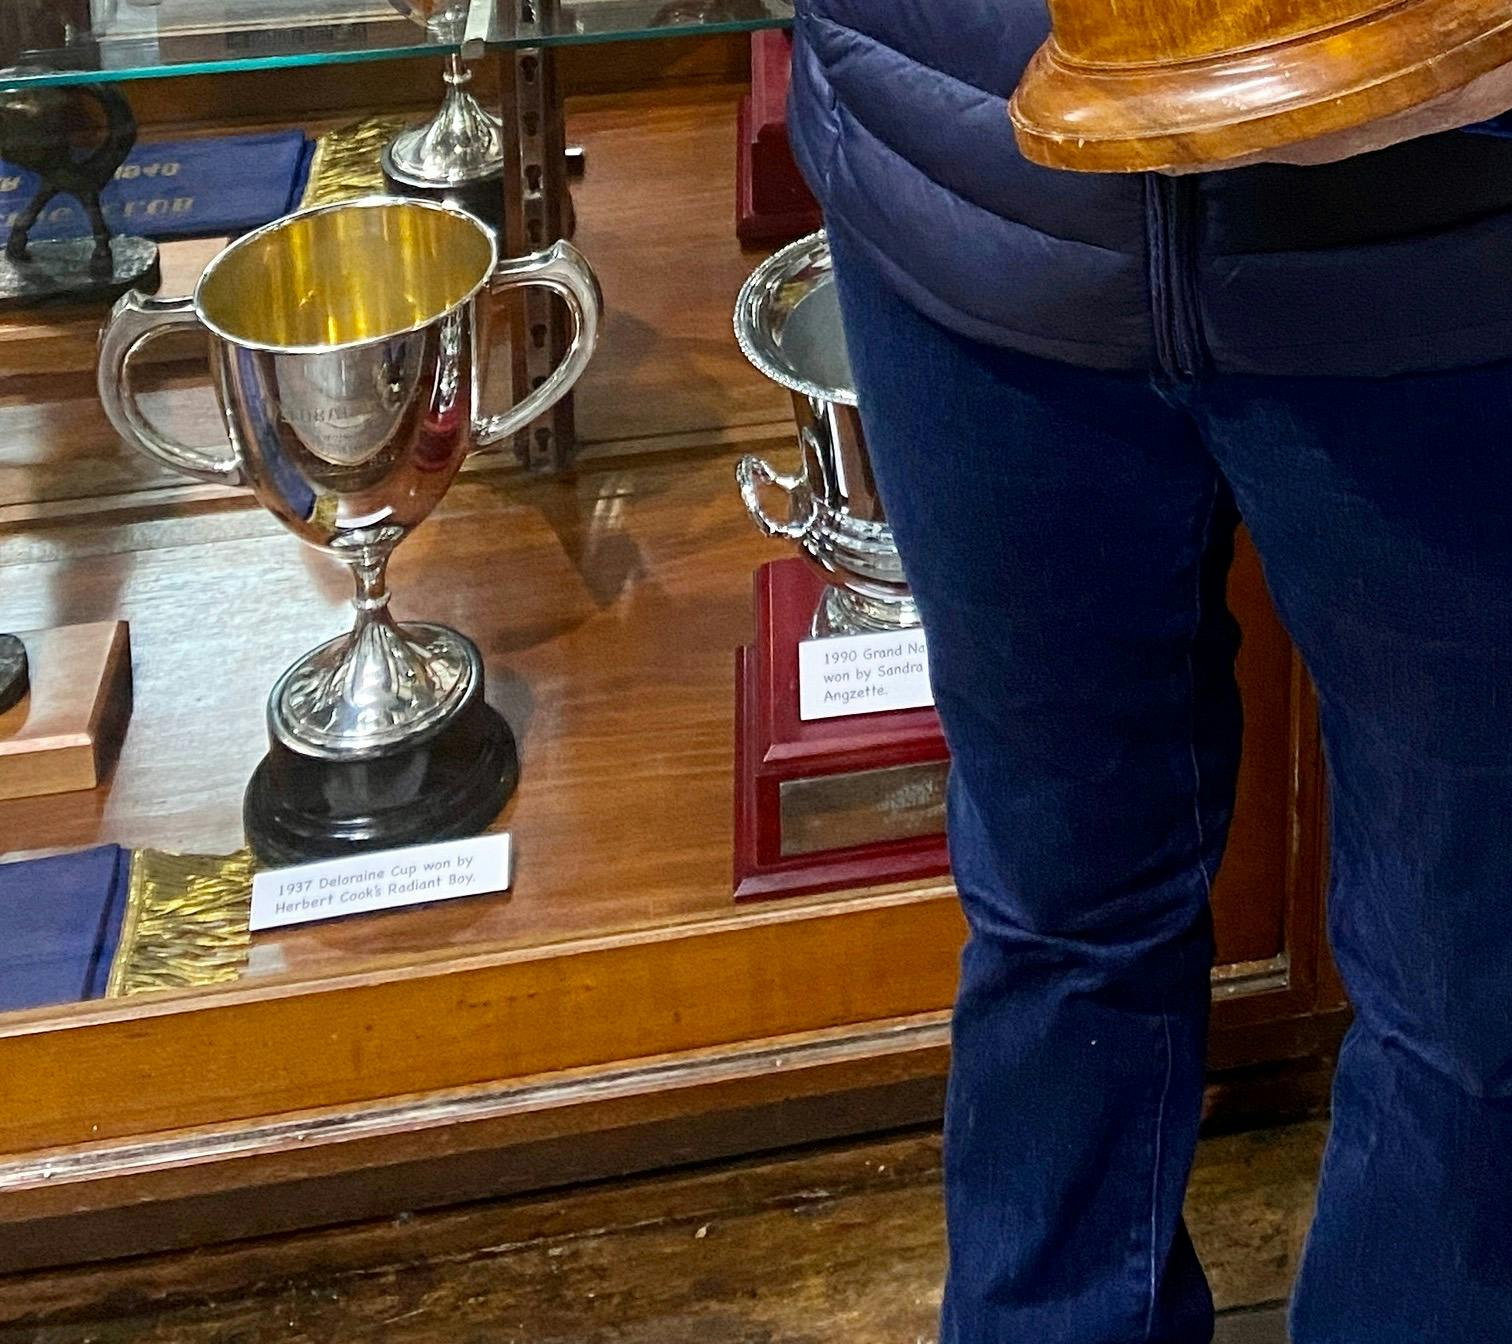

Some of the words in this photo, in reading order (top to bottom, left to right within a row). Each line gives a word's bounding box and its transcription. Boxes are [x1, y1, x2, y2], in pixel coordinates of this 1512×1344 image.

[824, 650, 857, 665] 1990
[863, 645, 903, 661] Grand
[908, 643, 926, 655] Na
[824, 671, 850, 684] won
[855, 668, 872, 683] by
[878, 661, 924, 676] Sandra
[823, 686, 888, 705] Angzette.
[278, 880, 313, 897] 1937
[319, 868, 385, 890] Deloraine
[391, 864, 417, 882] Cup
[422, 859, 451, 873] won
[457, 855, 474, 870] by
[275, 895, 334, 915] Herbert
[339, 884, 383, 903] Cook's
[387, 877, 443, 896] Radiant
[448, 873, 476, 887] Boy.
